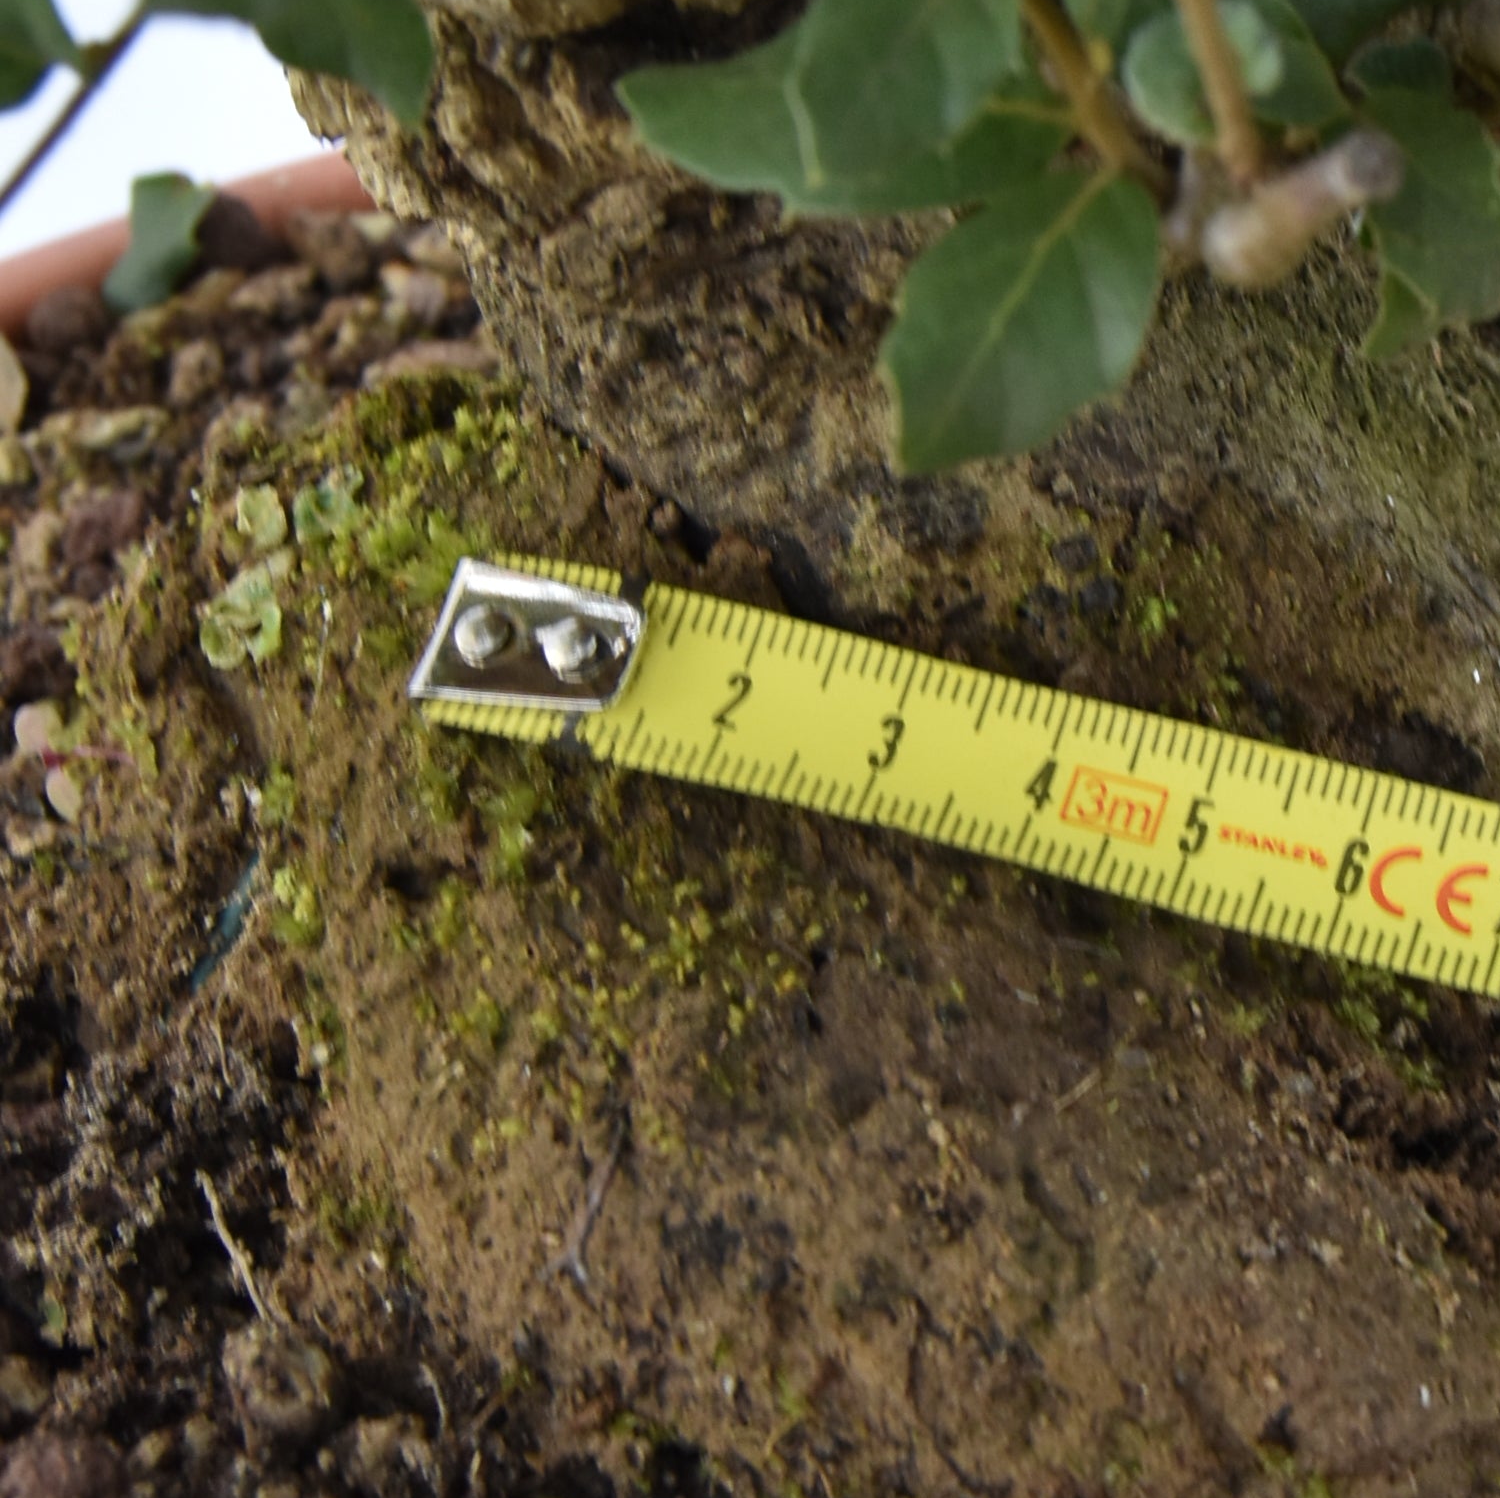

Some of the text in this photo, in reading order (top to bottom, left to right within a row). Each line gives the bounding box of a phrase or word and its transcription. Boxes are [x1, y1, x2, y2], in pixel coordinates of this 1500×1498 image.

[713, 673, 752, 731] 2
[869, 714, 905, 771] 3
[1025, 759, 1057, 811] 4
[1077, 778, 1154, 836] 3m
[1178, 796, 1215, 854] 5
[1335, 839, 1370, 897] 6
[1369, 846, 1489, 934] CE
